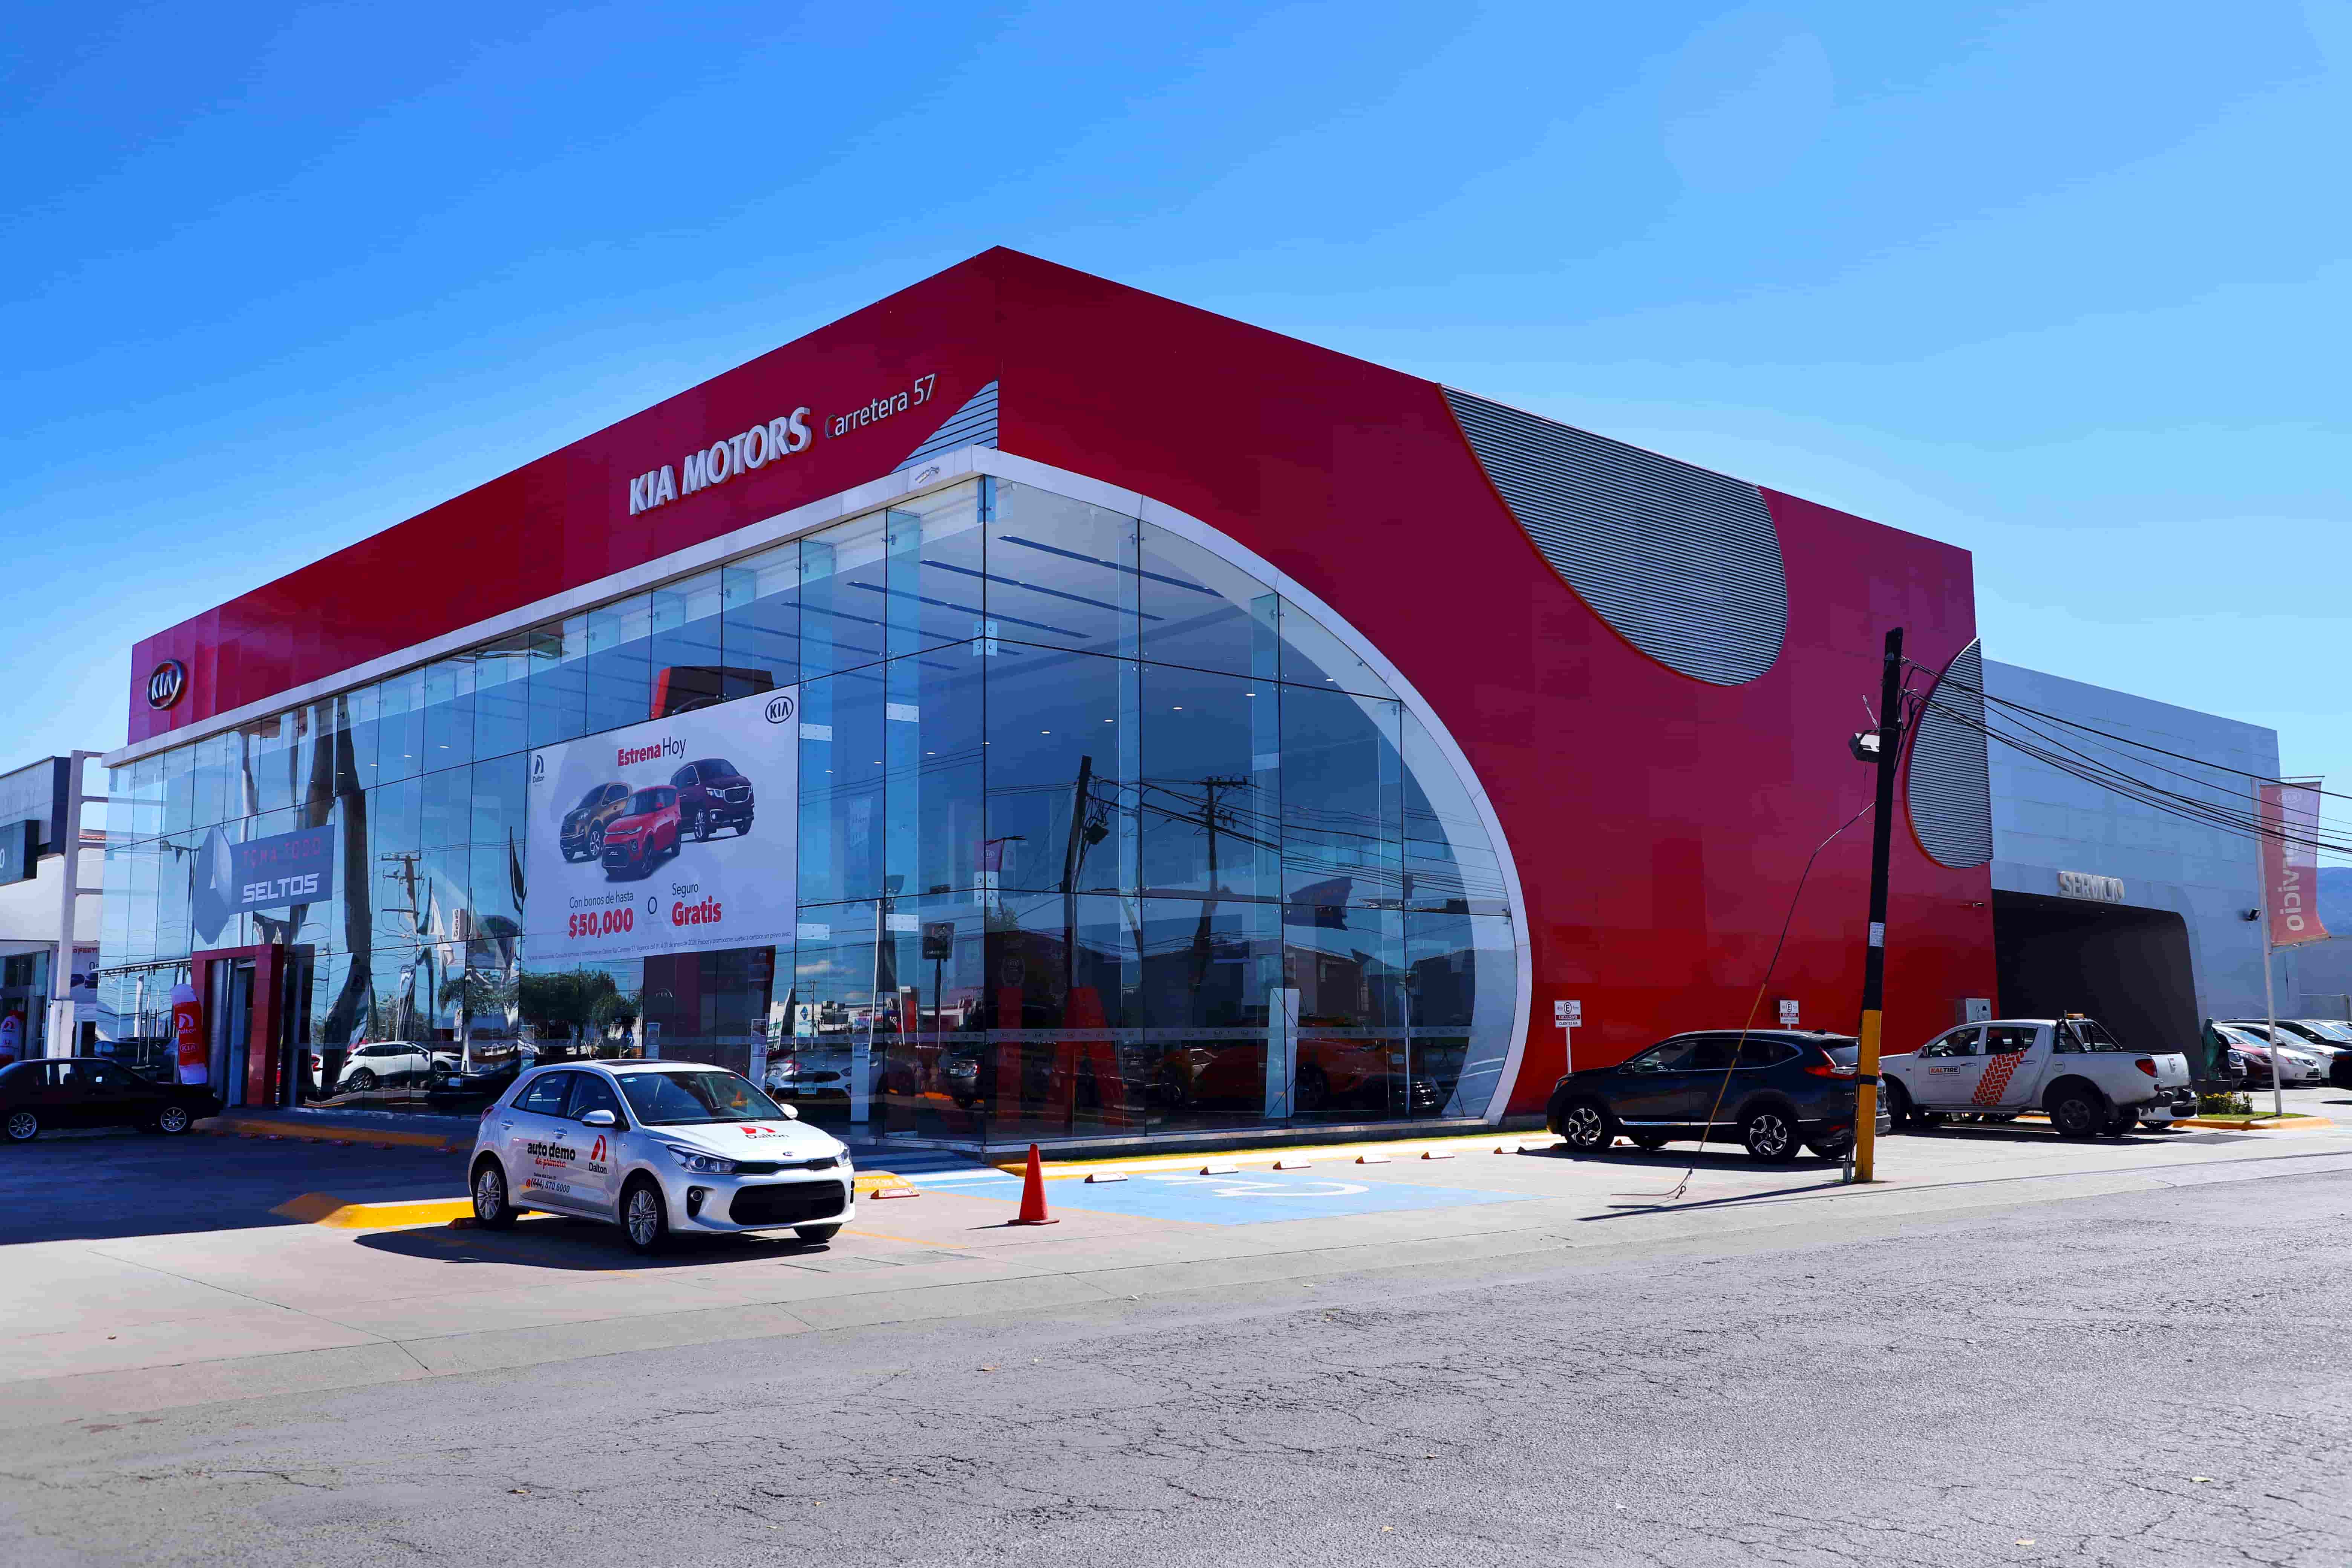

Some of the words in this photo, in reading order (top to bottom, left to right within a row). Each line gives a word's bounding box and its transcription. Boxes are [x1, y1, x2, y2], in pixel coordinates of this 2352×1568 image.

[825, 391, 908, 439] Carretera
[913, 373, 936, 406] 57
[630, 464, 679, 516] KIA
[681, 407, 812, 495] MOTORS
[152, 670, 173, 700] KIA
[770, 701, 789, 719] KIA
[617, 744, 661, 767] Estrena
[662, 735, 687, 759] Hoy
[241, 873, 320, 903] SELTOS
[569, 897, 582, 909] Con
[583, 896, 604, 906] bonos
[605, 893, 614, 905] de
[616, 891, 634, 903] hasta
[672, 882, 699, 898] Seguro
[2058, 871, 2125, 901] SERVICIO
[568, 907, 634, 940] $50,000
[672, 895, 722, 927] Gratis
[527, 1142, 548, 1156] auto
[548, 1142, 576, 1161] demo
[535, 1156, 543, 1165] de
[543, 1159, 567, 1170] primera
[589, 1162, 607, 1174] Dalton
[531, 1178, 544, 1190] (444)
[545, 1181, 555, 1190] 870
[556, 1183, 570, 1193] 6000
